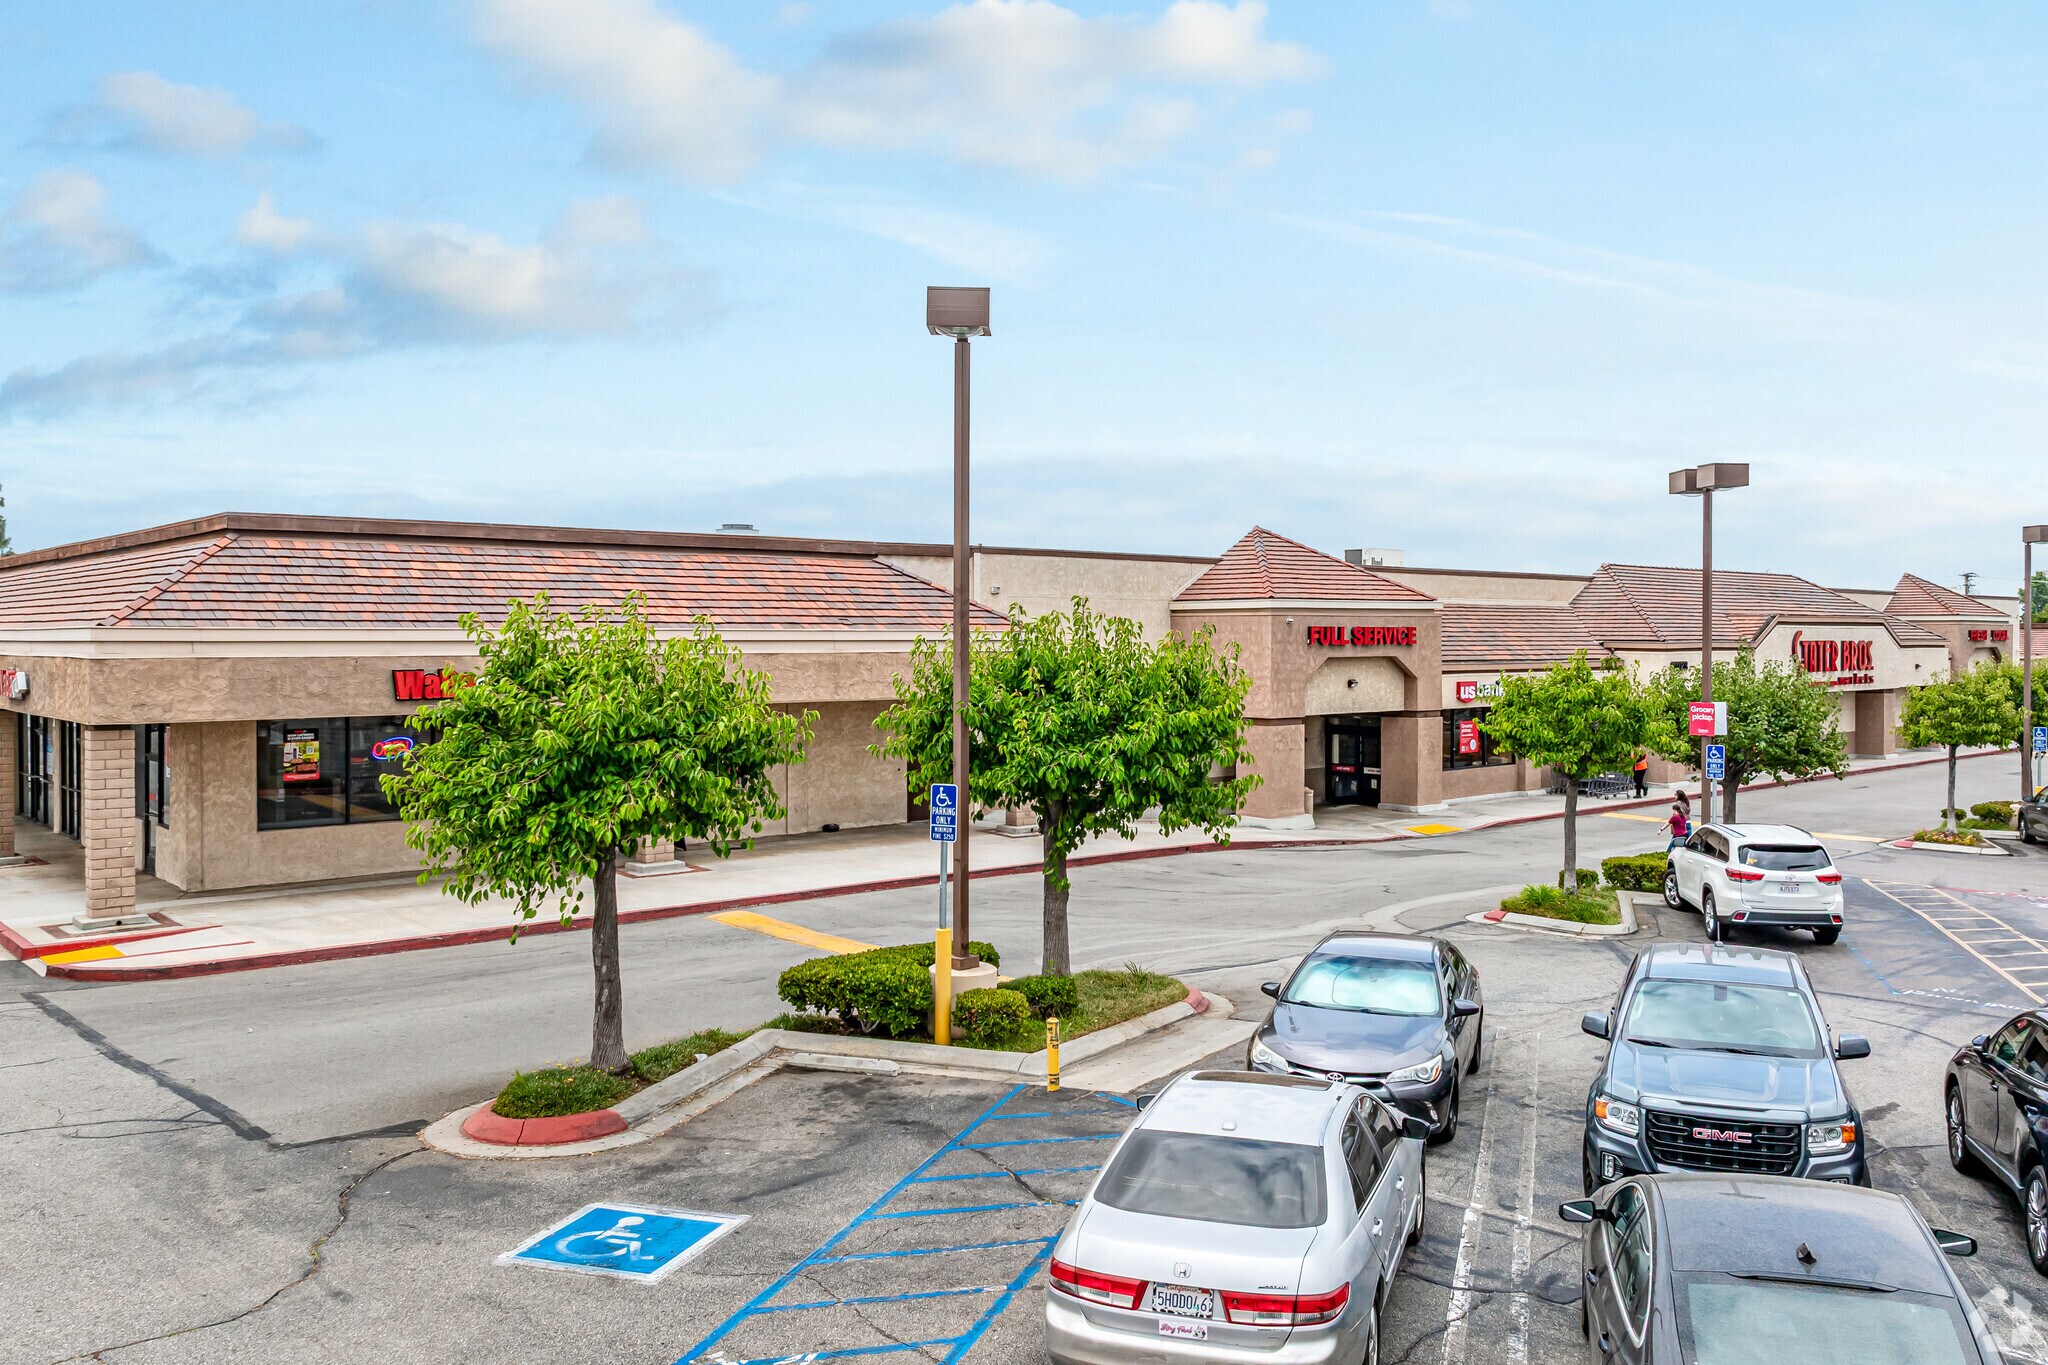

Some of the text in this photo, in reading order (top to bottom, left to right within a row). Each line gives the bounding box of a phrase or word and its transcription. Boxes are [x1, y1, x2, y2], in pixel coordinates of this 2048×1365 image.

[1309, 626, 1417, 645] FULL SERVICE
[1841, 640, 1874, 670] BROS.
[1461, 685, 1476, 699] us
[1690, 705, 1714, 715] Grocery
[1691, 714, 1713, 722] pickup.
[932, 807, 956, 816] PARKING
[935, 816, 952, 825] ONLY
[1693, 1127, 1752, 1144] GMC
[1166, 1284, 1201, 1294] California
